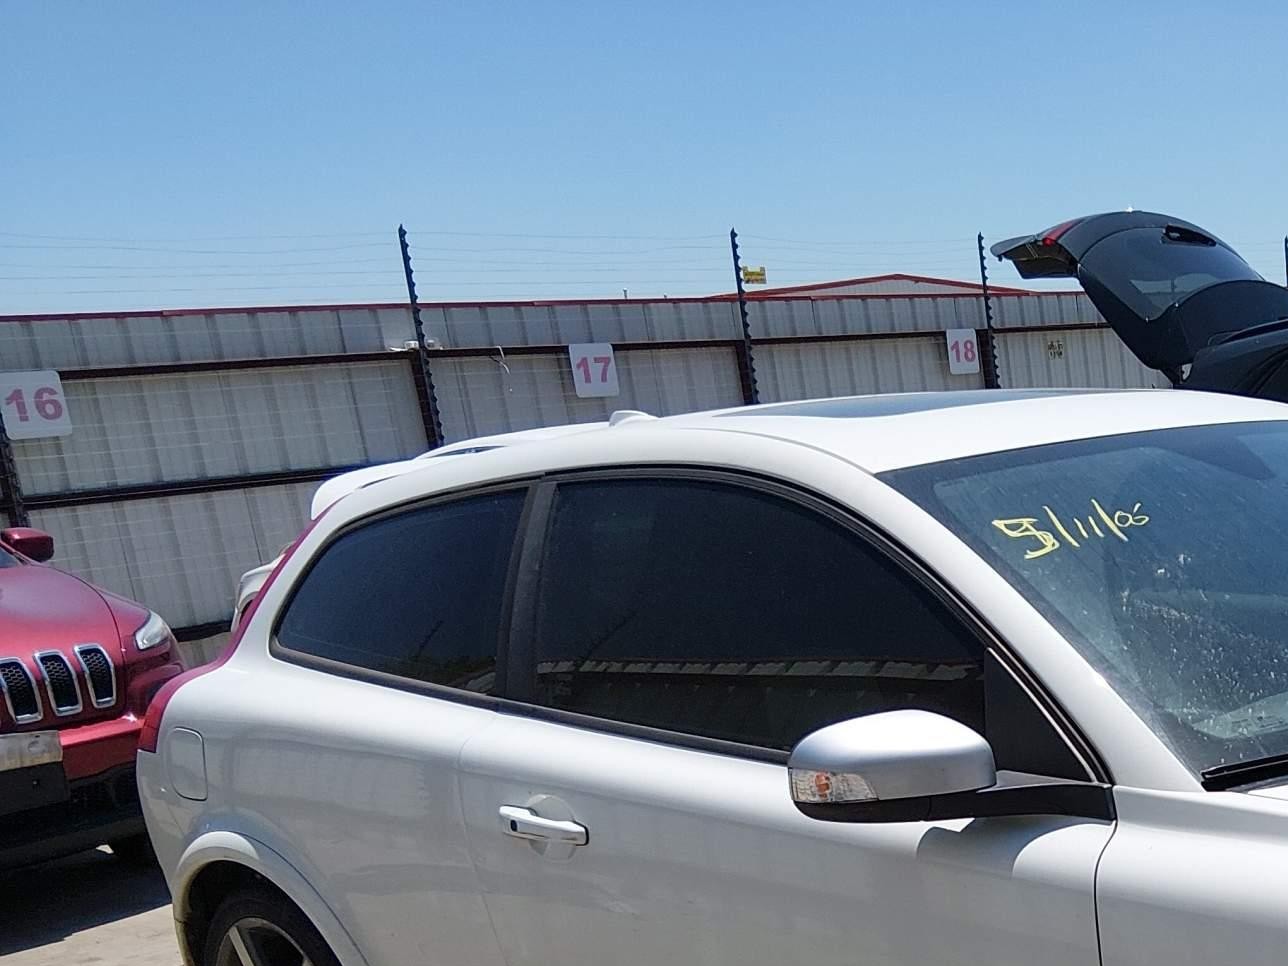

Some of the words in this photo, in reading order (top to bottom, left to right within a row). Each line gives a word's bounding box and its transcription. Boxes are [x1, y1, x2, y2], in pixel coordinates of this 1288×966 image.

[951, 340, 976, 363] 18
[576, 356, 610, 384] 17
[5, 387, 63, 422] 16
